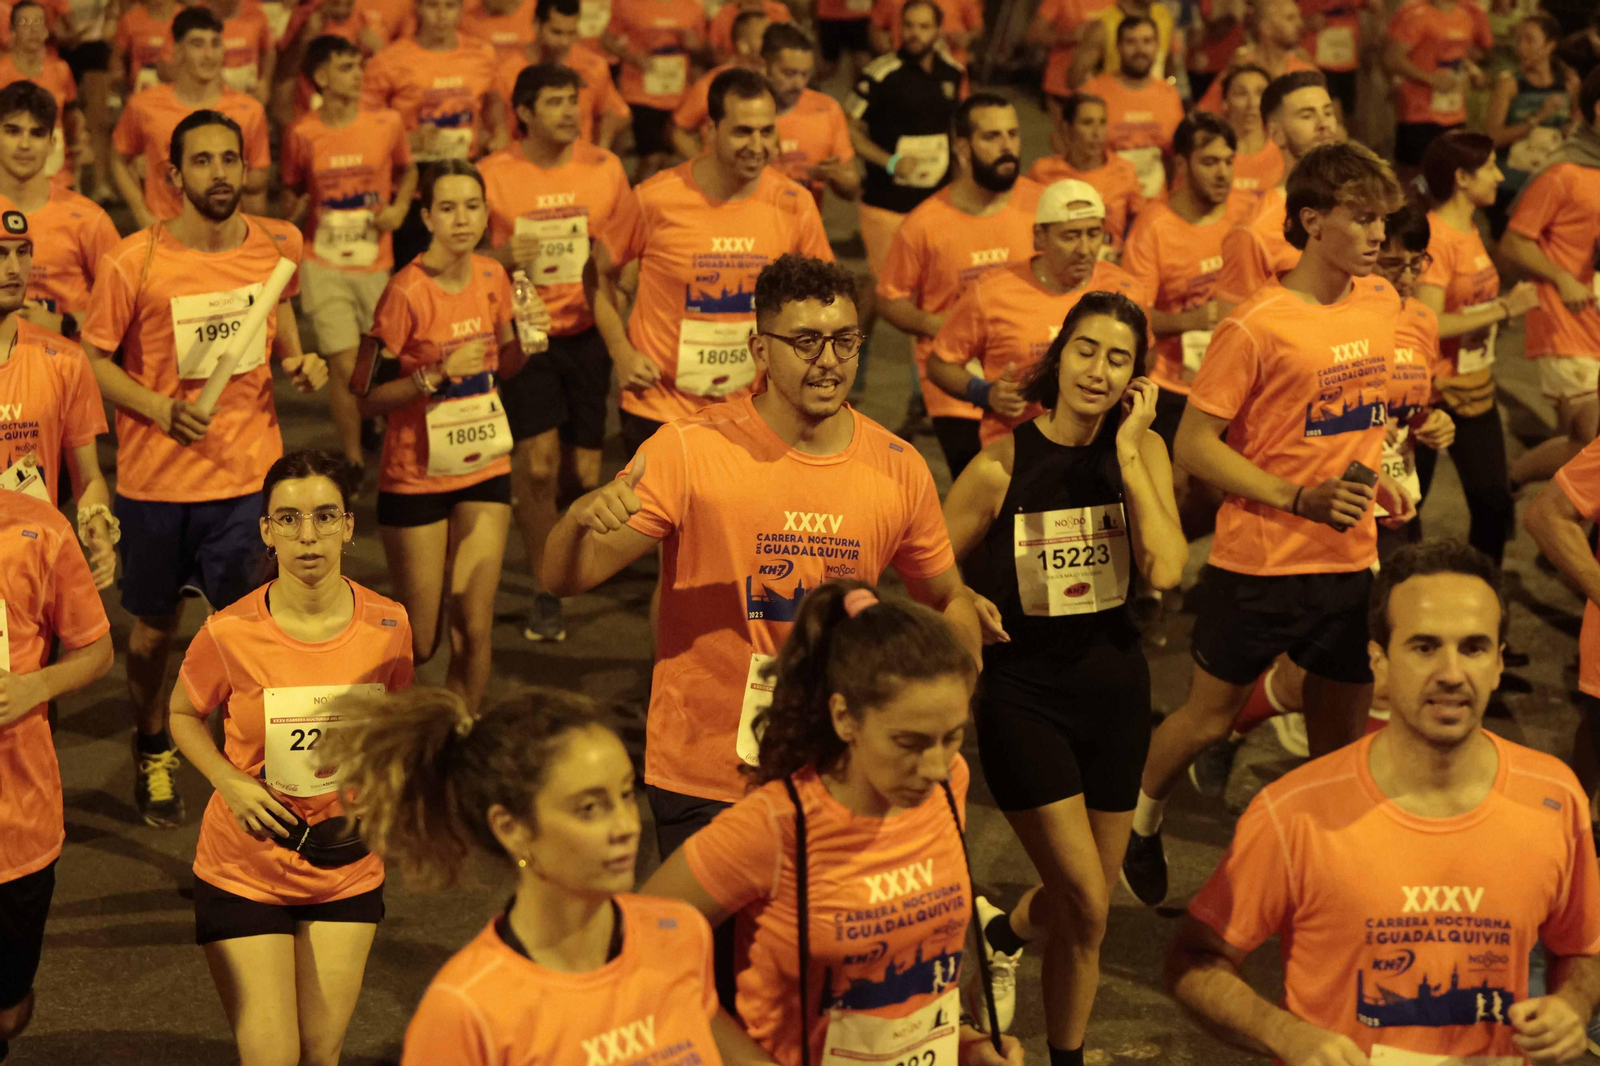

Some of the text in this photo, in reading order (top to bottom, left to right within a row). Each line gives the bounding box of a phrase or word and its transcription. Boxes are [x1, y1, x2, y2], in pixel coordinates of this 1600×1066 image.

[711, 236, 755, 252] XXXV
[971, 247, 1010, 265] XXXV
[697, 348, 748, 365] 18058
[1331, 338, 1370, 363] XXXV
[1318, 356, 1385, 377] CARRERA NOCTURNA
[1324, 364, 1386, 386] GUADALQUIVIR
[446, 423, 497, 446] 18053
[783, 510, 844, 535] XXXV
[757, 533, 861, 549] CARRERA NOCTURNA
[763, 543, 860, 561] GUADALQUIVIR
[1037, 543, 1110, 571] 15223
[864, 858, 934, 904] XXXV
[834, 883, 962, 925] CARRERA NOCTURNA
[1401, 885, 1485, 913] XXXV
[846, 895, 965, 940] GUADALQUIVIR
[1365, 915, 1512, 929] CARRERA NOCTURNA
[1376, 929, 1511, 946] GUADALQUIVIR
[581, 1014, 656, 1066] XXXV
